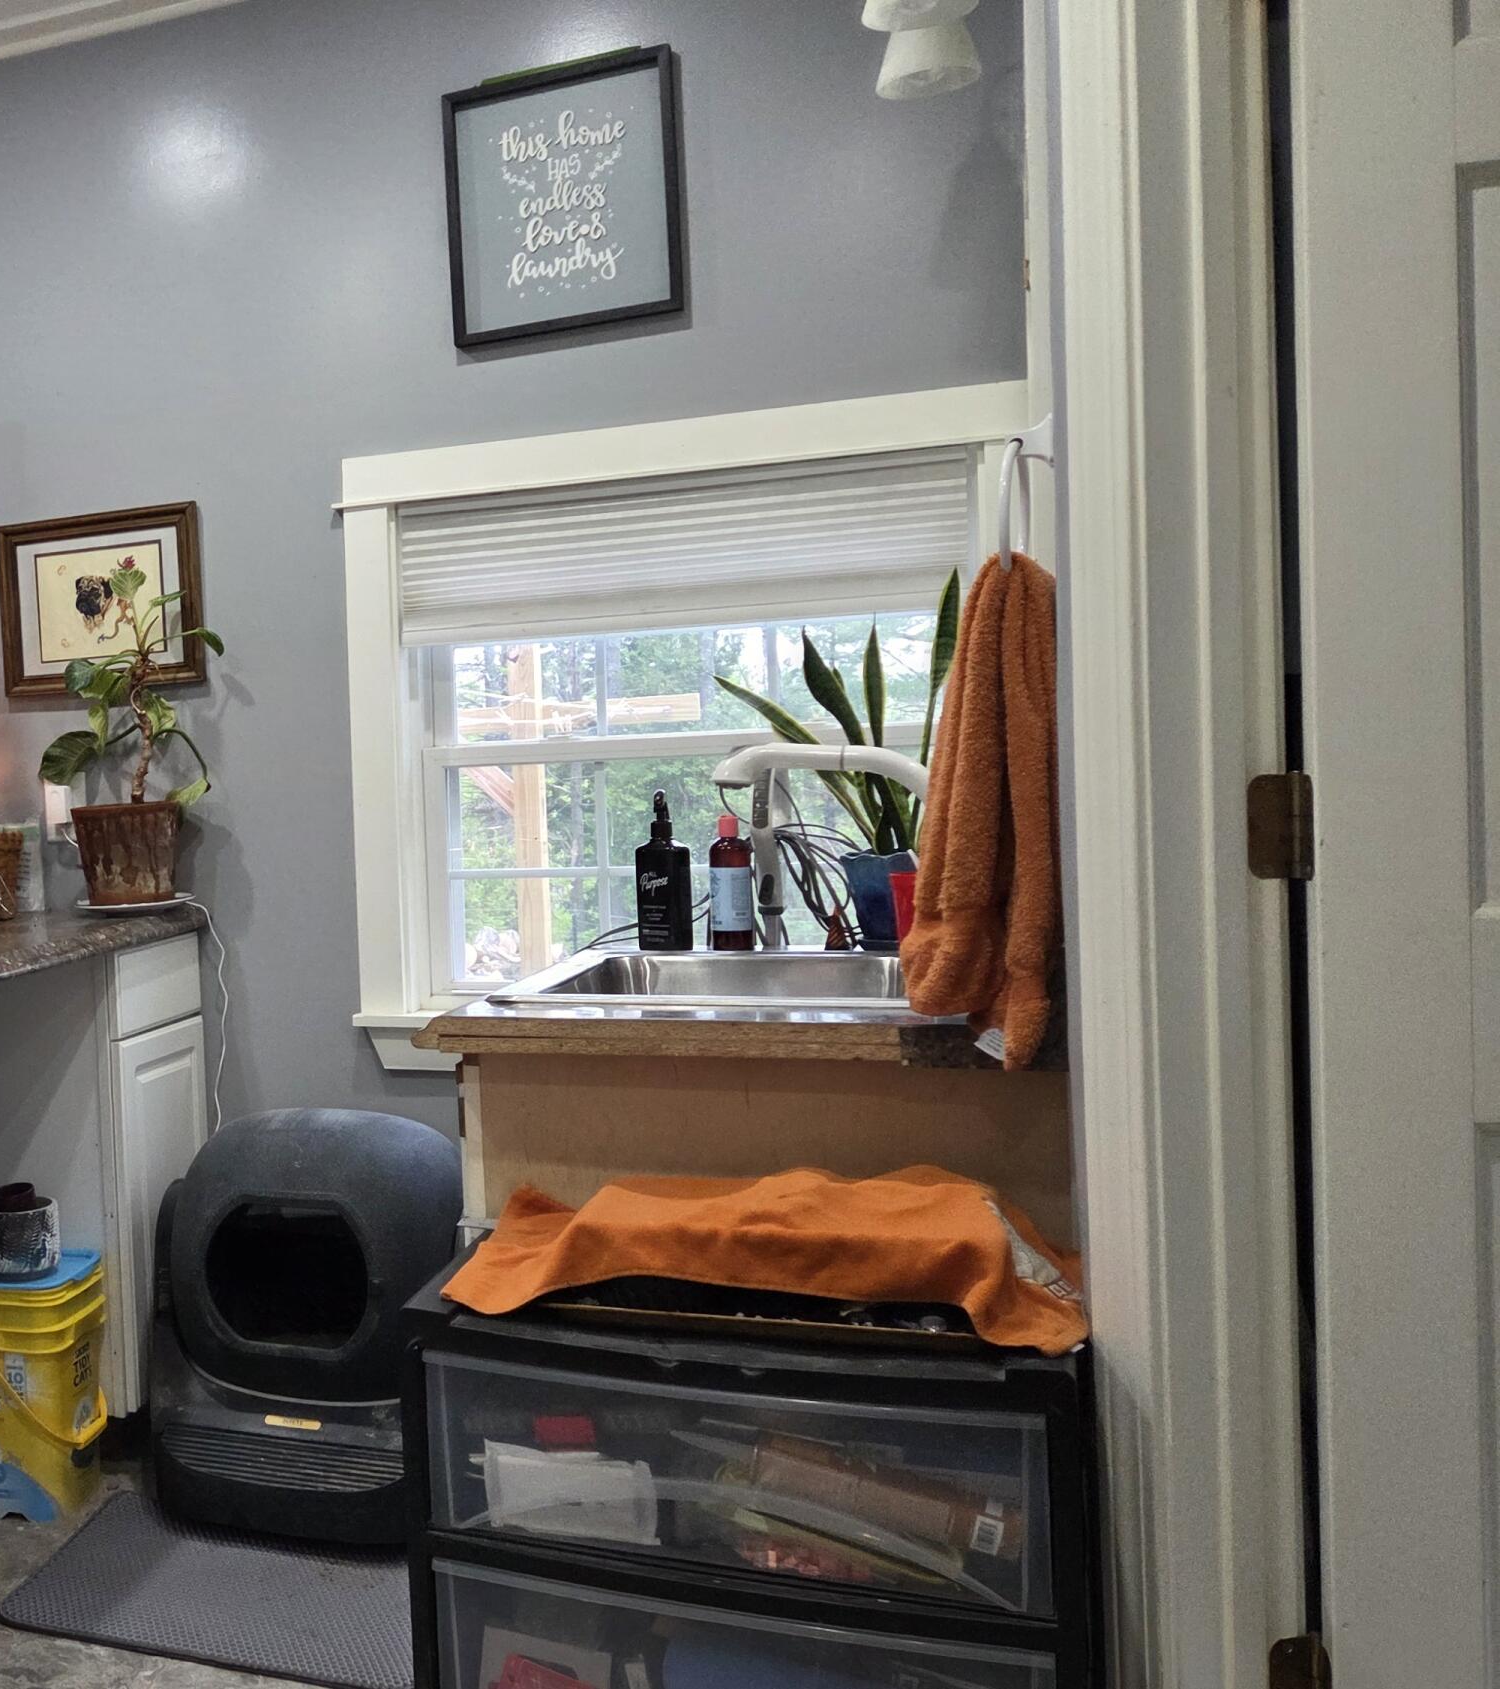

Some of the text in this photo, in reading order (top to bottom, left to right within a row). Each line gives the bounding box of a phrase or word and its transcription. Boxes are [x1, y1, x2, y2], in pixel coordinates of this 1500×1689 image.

[498, 110, 626, 163] this home
[547, 153, 581, 181] HAS
[518, 179, 607, 219] endless
[521, 216, 580, 253] love
[507, 238, 625, 289] laundry
[639, 873, 669, 897] Purpose
